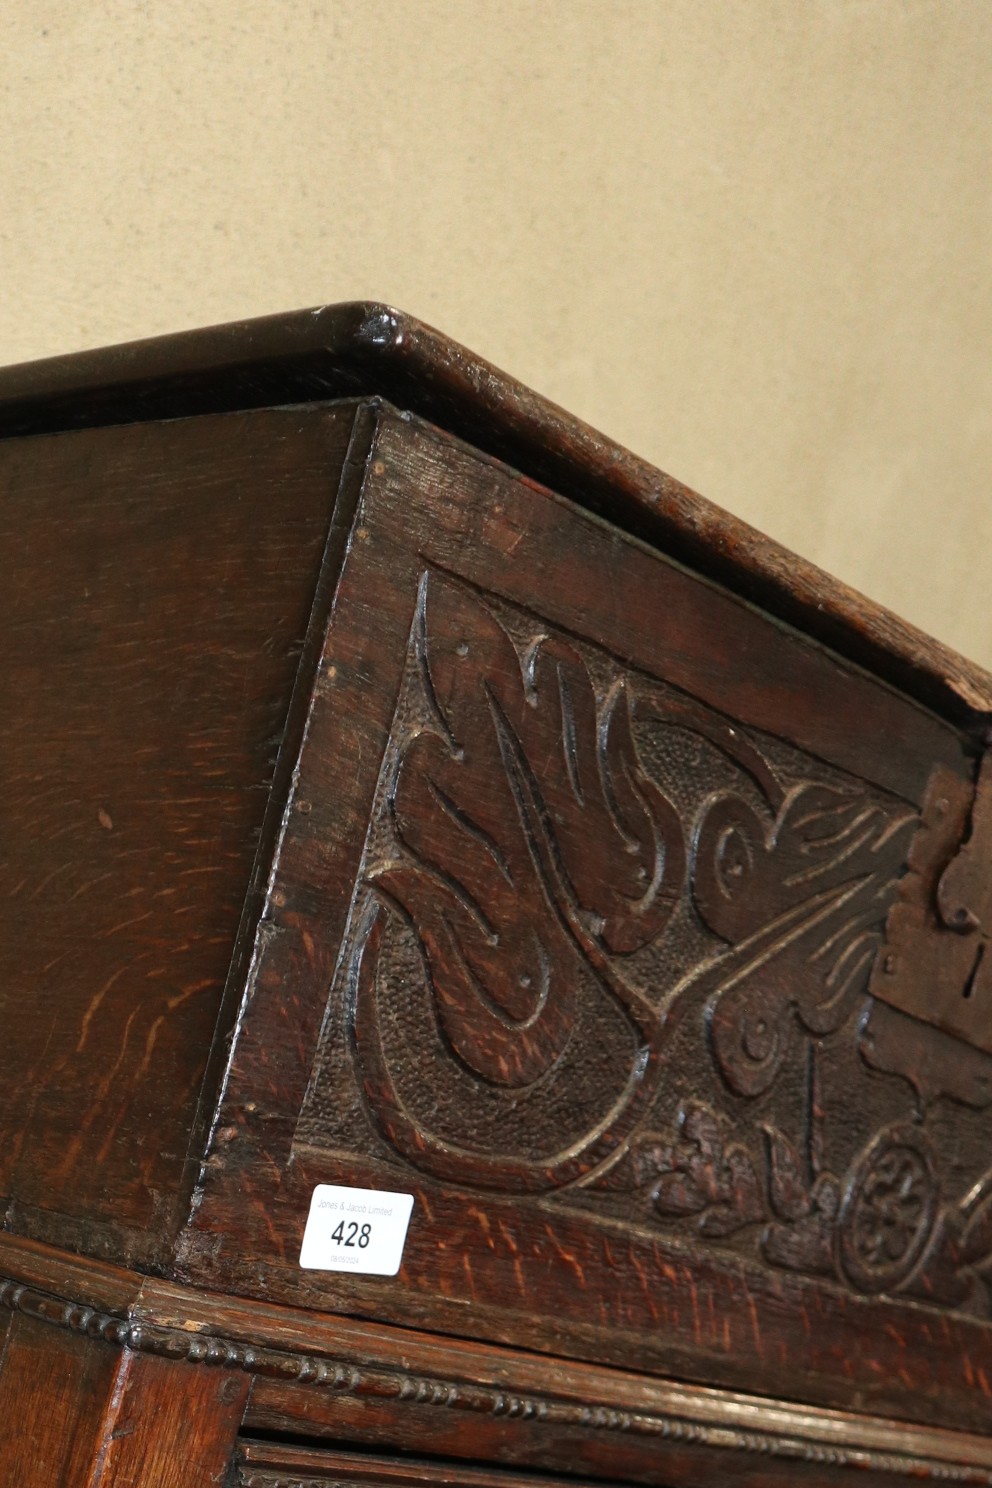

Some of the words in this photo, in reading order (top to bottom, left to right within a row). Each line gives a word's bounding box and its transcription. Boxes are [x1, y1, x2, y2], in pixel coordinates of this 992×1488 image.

[317, 1199, 338, 1210] Jones
[339, 1201, 345, 1211] &
[346, 1202, 367, 1213] Jacob
[331, 1220, 371, 1248] 428
